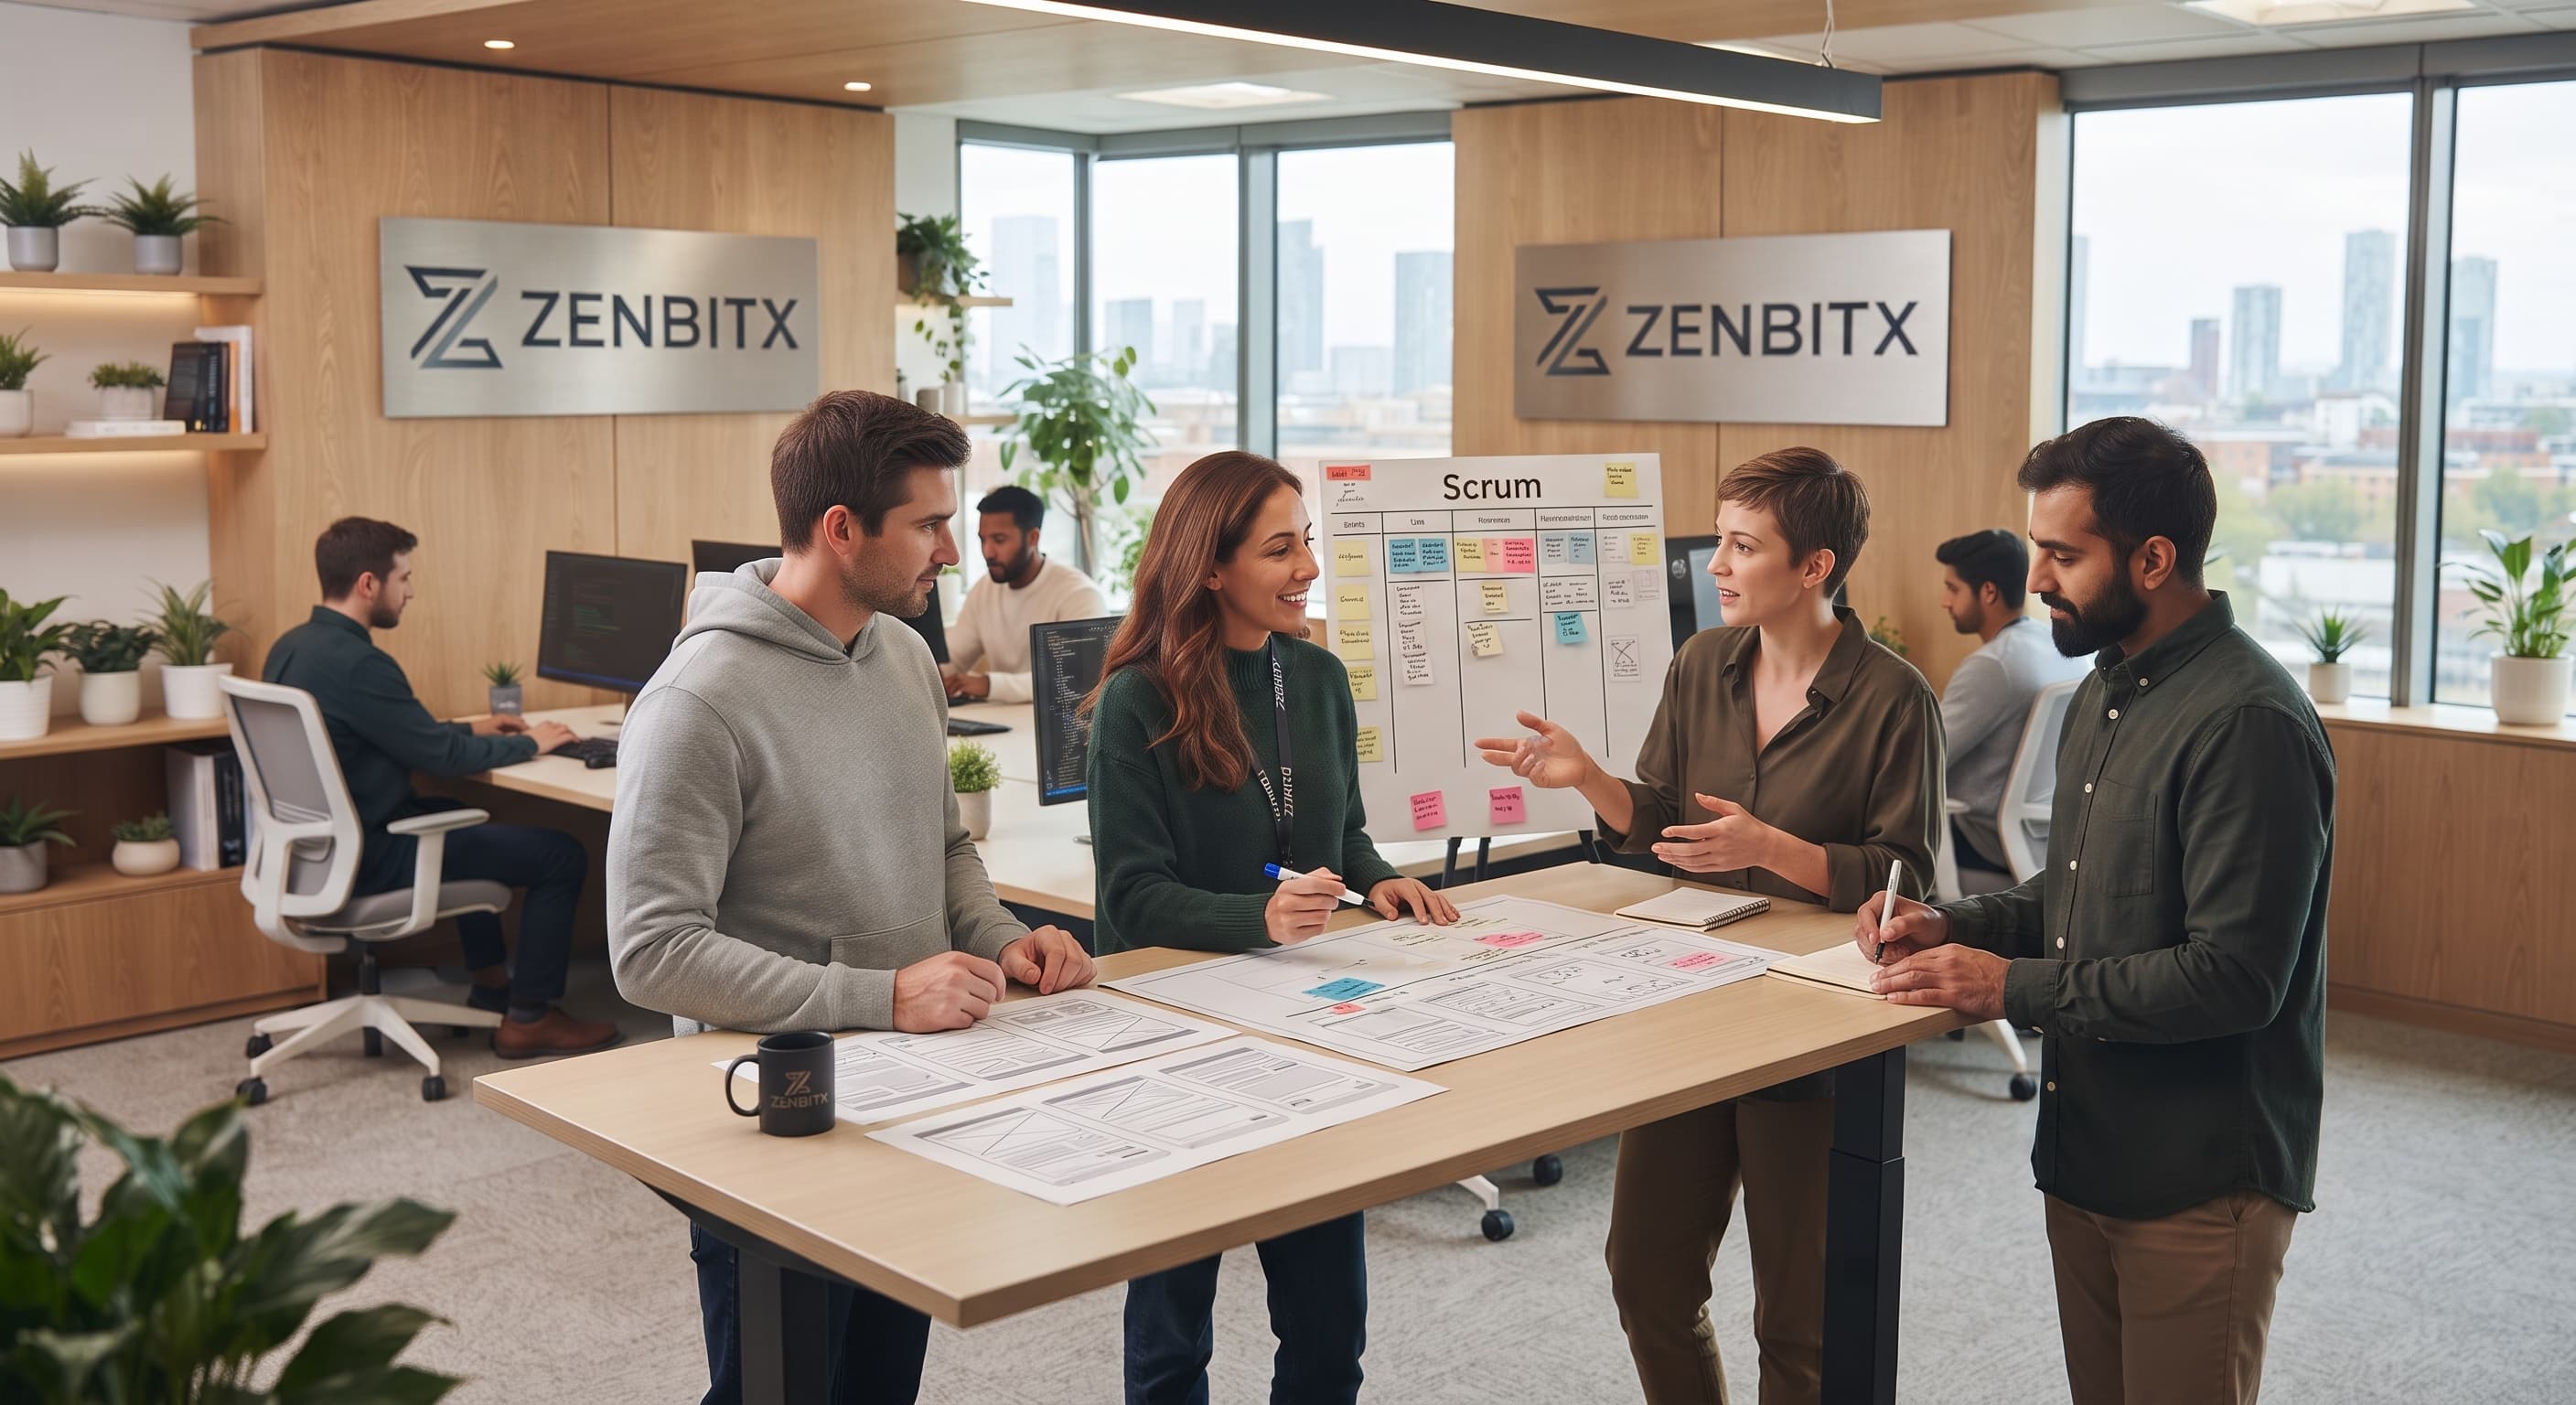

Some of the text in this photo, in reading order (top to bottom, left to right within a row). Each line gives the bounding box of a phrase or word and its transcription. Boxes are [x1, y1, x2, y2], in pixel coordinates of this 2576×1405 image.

[521, 290, 800, 350] ZENBITX
[1625, 301, 1919, 358] ZENBITX
[1443, 473, 1542, 500] Scrum
[770, 1092, 829, 1109] ZENBITX
